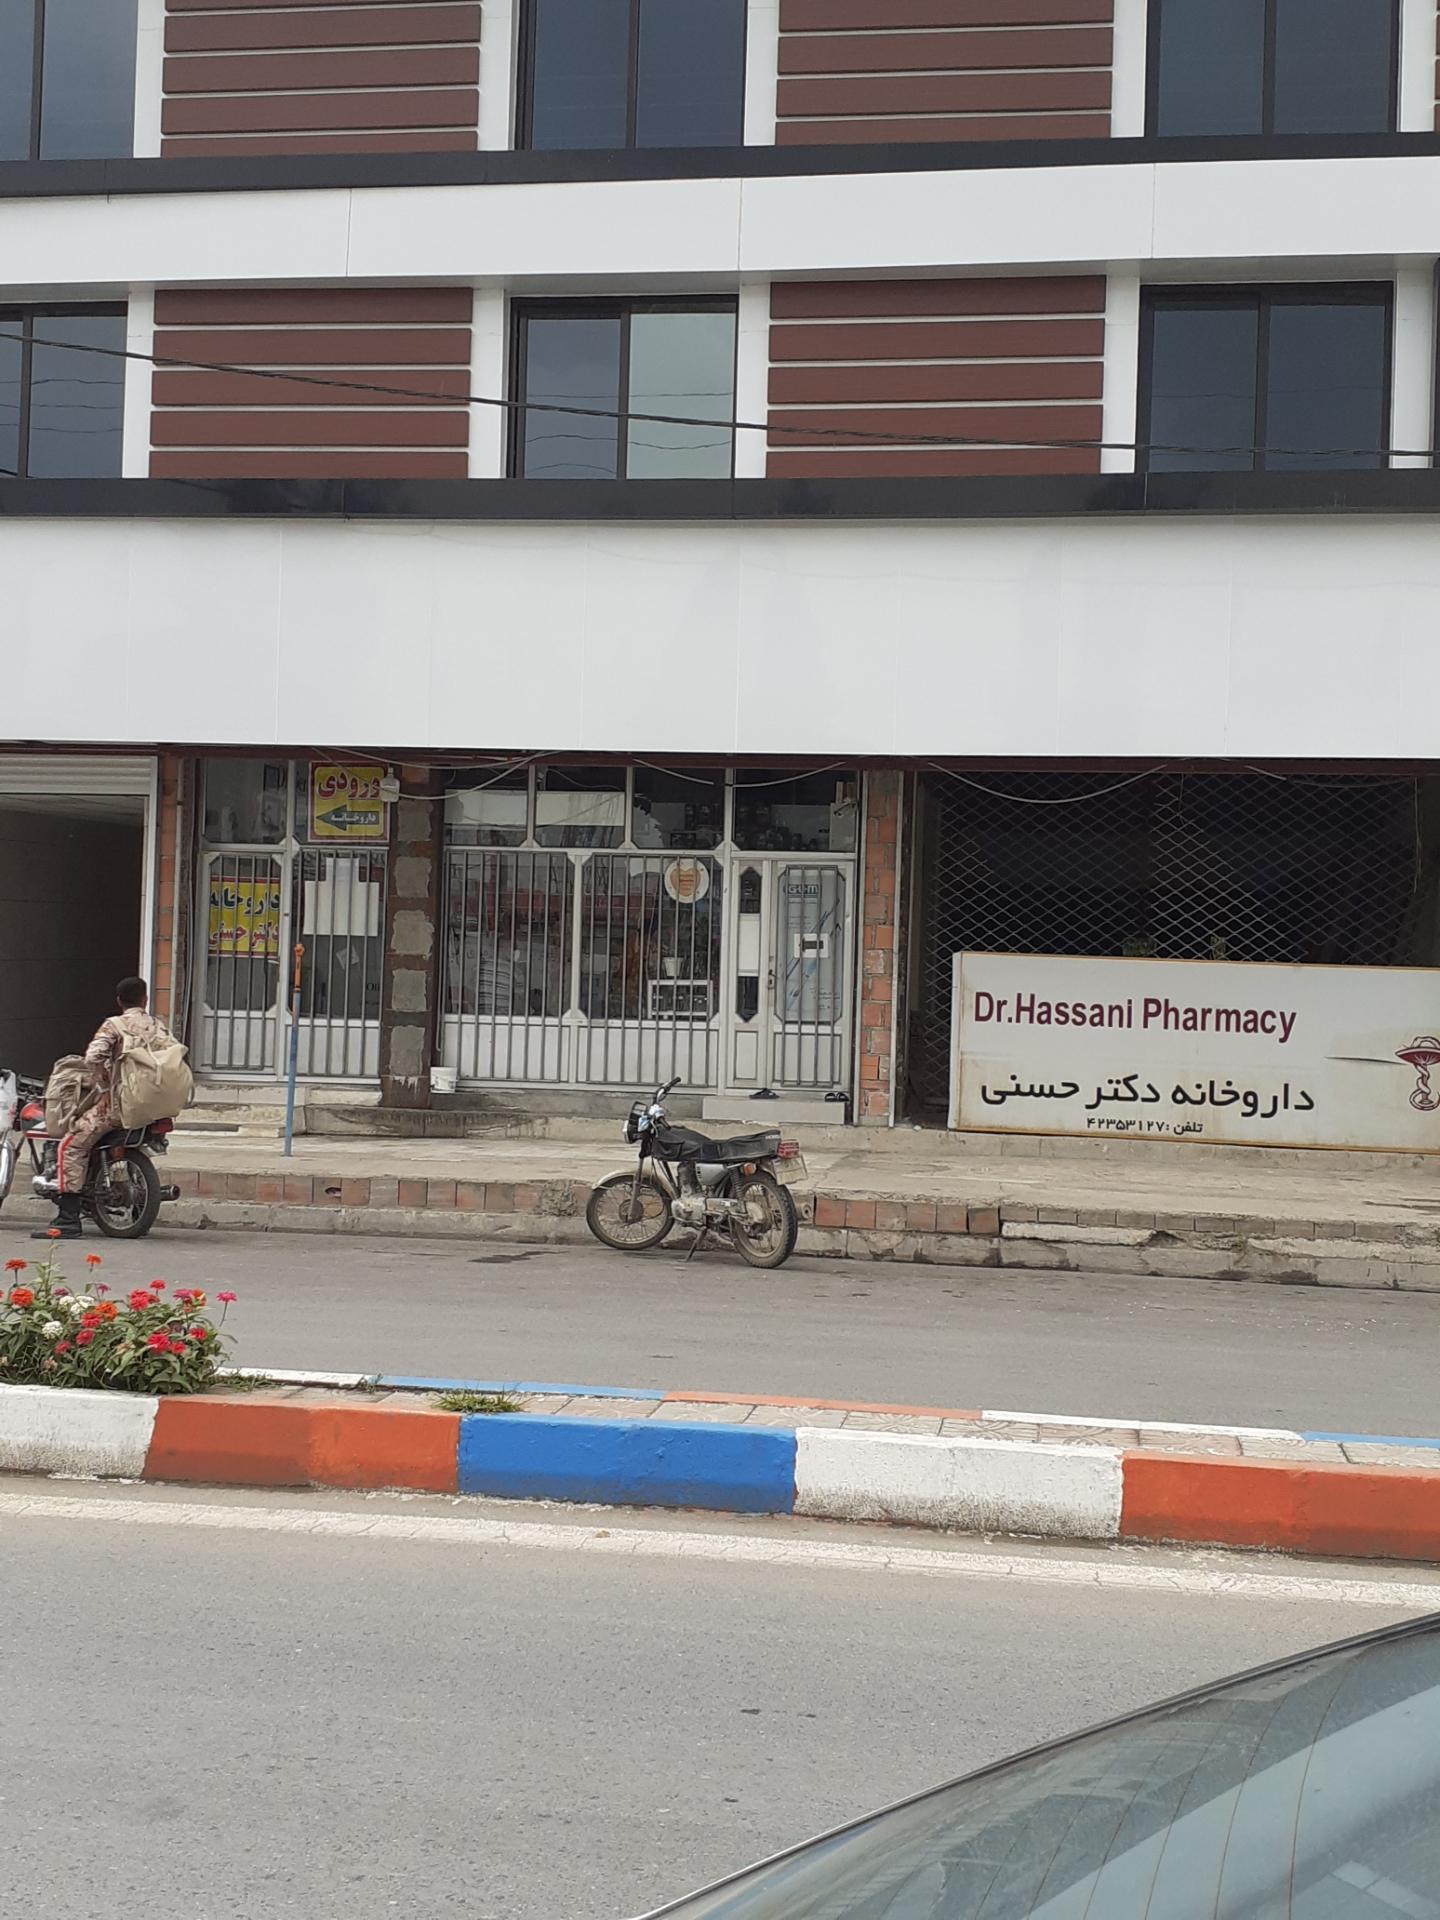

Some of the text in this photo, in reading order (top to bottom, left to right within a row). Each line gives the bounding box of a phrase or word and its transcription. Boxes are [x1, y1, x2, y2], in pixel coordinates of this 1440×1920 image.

[318, 772, 380, 798] ورودی
[974, 991, 1297, 1044] Dr.Hassani Pharmacy
[981, 1073, 1316, 1119] داروخانه دکتر حسنی
